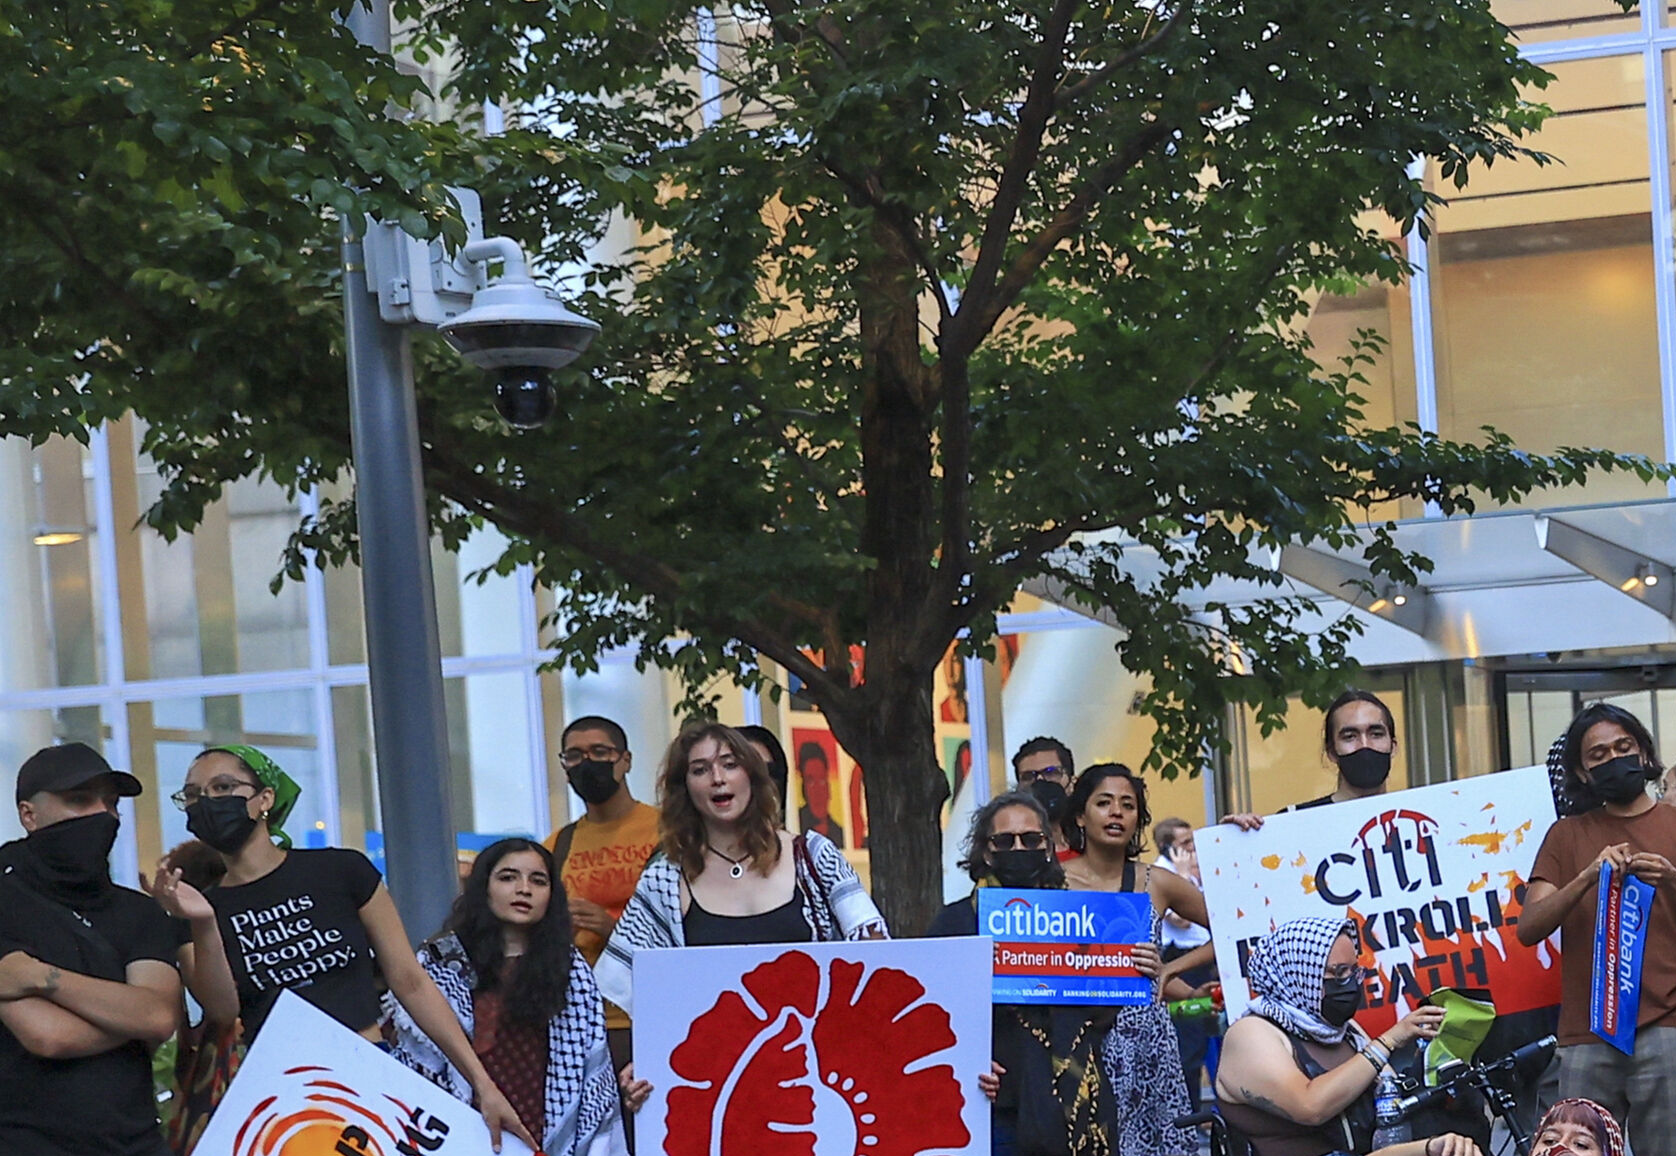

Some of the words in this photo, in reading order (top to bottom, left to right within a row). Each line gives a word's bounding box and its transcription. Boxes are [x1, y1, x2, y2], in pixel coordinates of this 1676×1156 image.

[230, 894, 315, 934] Plants
[988, 903, 1096, 937] citibank
[1607, 889, 1618, 932] Partner
[237, 917, 313, 953] Make
[243, 928, 343, 973] People
[1609, 935, 1617, 950] in
[1621, 884, 1641, 996] citibank
[250, 945, 357, 991] Happy.
[1002, 950, 1048, 966] Partner
[1050, 951, 1063, 967] in
[1065, 951, 1135, 970] Oppressio
[1606, 953, 1617, 1030] Oppression
